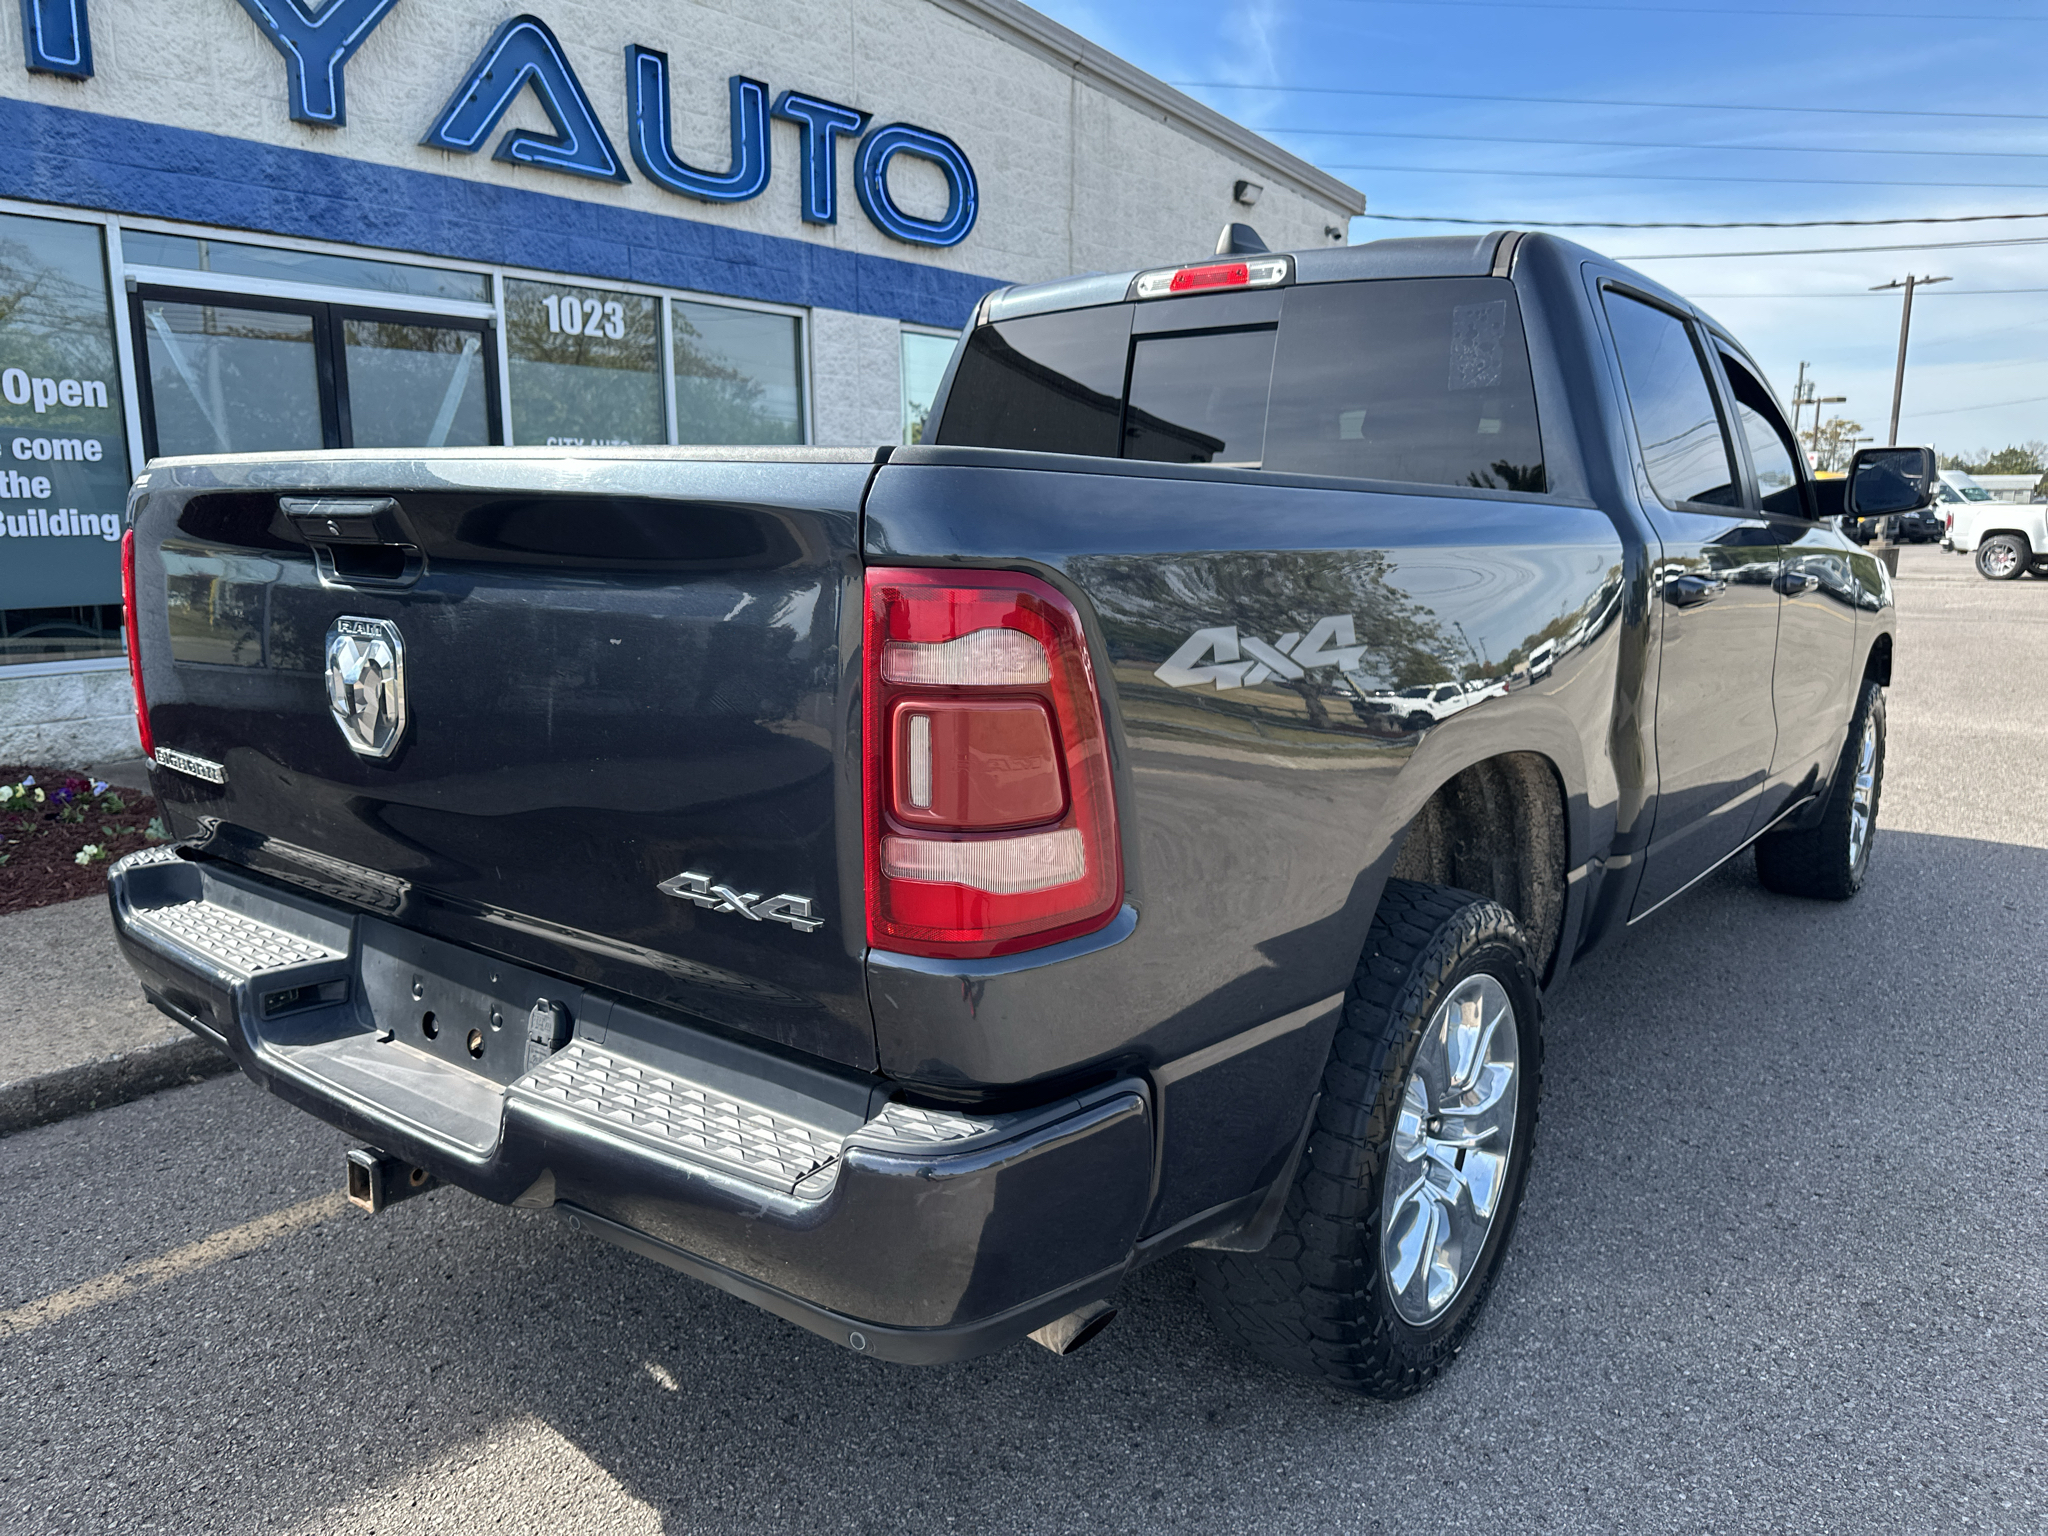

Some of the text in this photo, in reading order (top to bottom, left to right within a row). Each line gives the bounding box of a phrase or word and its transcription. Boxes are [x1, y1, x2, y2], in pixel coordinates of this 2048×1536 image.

[542, 295, 626, 340] 1023
[2, 368, 108, 413] Open
[12, 437, 103, 462] come
[0, 470, 51, 499] the
[337, 620, 382, 637] RAM
